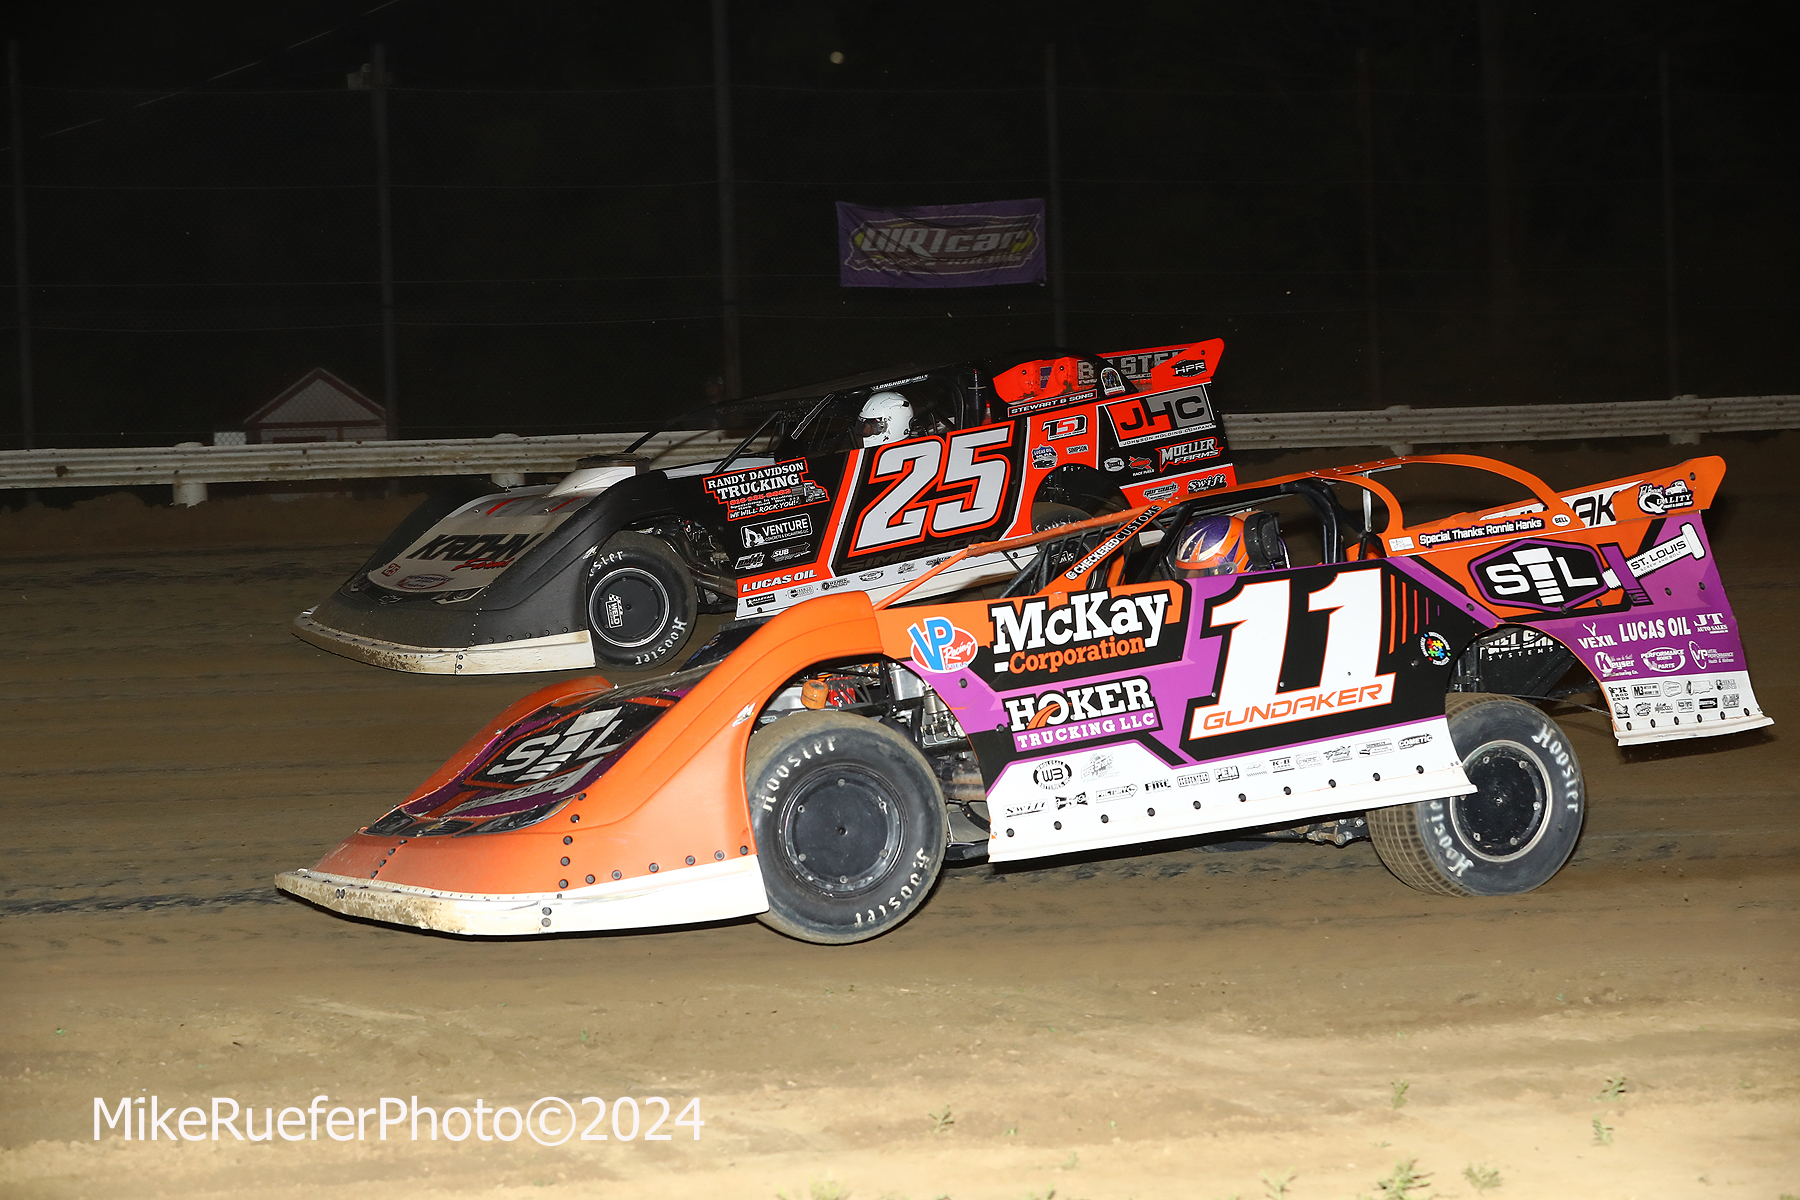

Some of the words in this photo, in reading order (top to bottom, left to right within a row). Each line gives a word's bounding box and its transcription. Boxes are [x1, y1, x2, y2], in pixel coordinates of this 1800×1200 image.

[1174, 362, 1205, 375] HPR
[1011, 400, 1058, 414] STEWART
[1069, 392, 1094, 401] SONS
[1120, 396, 1205, 431] JHC
[1161, 439, 1216, 463] MOELLER
[707, 474, 746, 489] RANDY
[748, 462, 804, 481] DAVIDSON
[717, 473, 800, 500] TRUCKING
[853, 424, 1010, 549] 25
[762, 518, 809, 537] VENTURE
[1419, 530, 1451, 547] Special
[1451, 528, 1485, 541] Thanks:
[1486, 522, 1515, 537] Ronnie
[1515, 519, 1542, 531] Hanks
[1630, 557, 1650, 570] ST.
[1649, 540, 1687, 563] LOUIS
[742, 574, 792, 593] LUCAS
[793, 569, 818, 582] OIL
[992, 592, 1169, 654] McKay
[1578, 634, 1618, 649] VEXIL
[1618, 618, 1667, 643] LUCAS
[1667, 616, 1692, 637] OIL
[1693, 612, 1724, 627] JT
[635, 617, 687, 665] Hoosier
[908, 617, 954, 671] VP
[943, 641, 975, 664] Racing
[1009, 636, 1145, 673] Corporation
[1191, 567, 1396, 724] 11
[1488, 646, 1554, 662] SYSTEMS
[1641, 649, 1685, 660] PERFORMANCE
[1005, 678, 1154, 732] HOKER
[1203, 683, 1383, 731] GUNDAKER
[1017, 719, 1117, 749] TRUCKING
[1118, 712, 1156, 728] LLC
[762, 735, 837, 813] Hoosier
[1531, 723, 1579, 814] Hoosier
[853, 847, 931, 928] Hoosier
